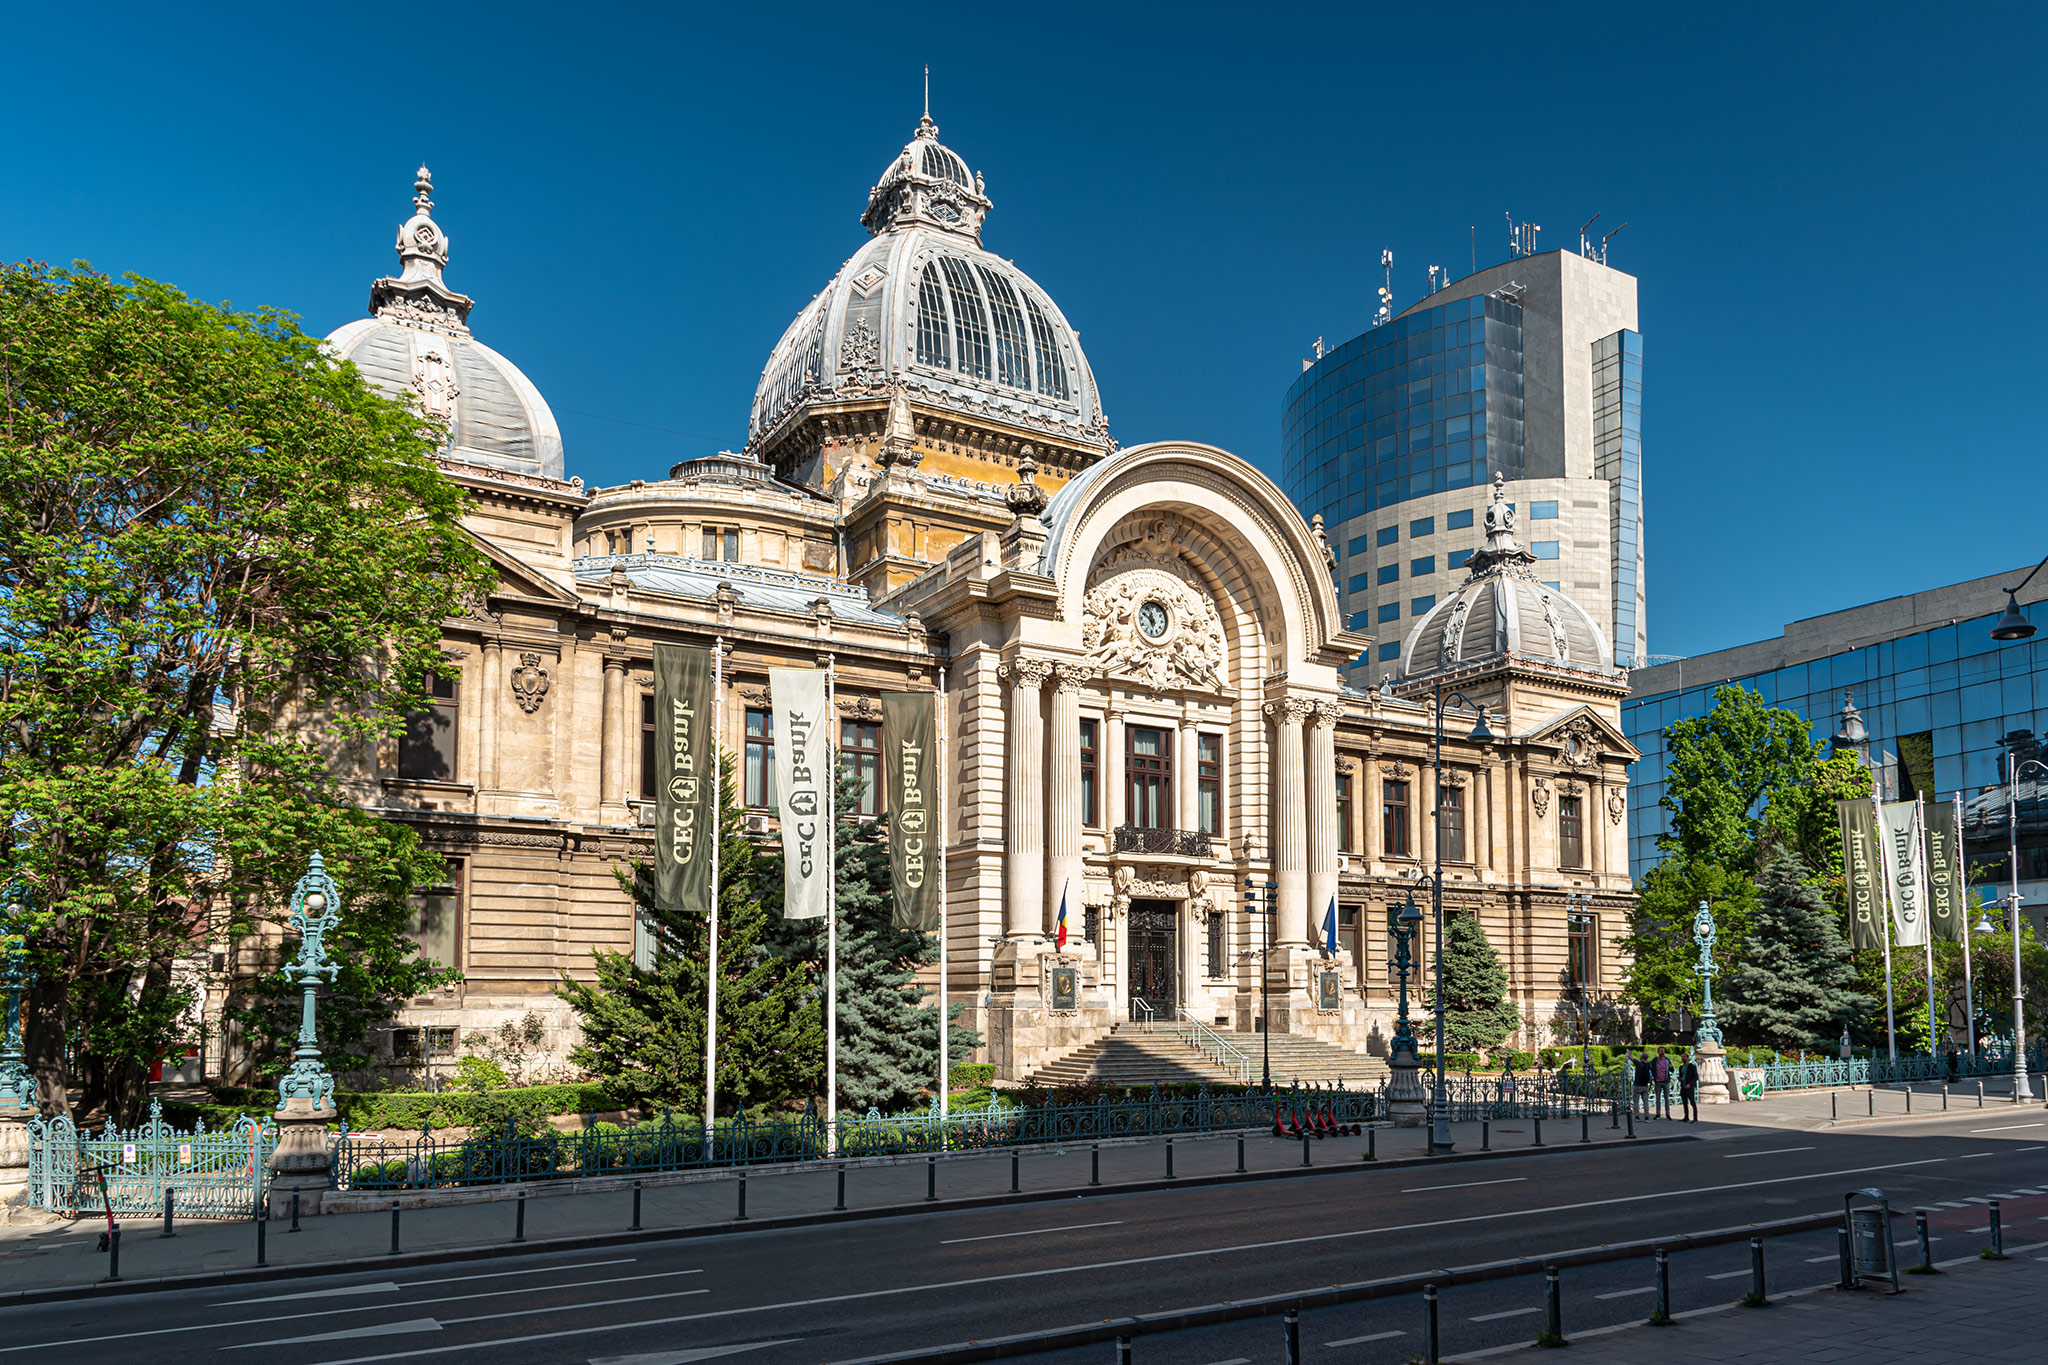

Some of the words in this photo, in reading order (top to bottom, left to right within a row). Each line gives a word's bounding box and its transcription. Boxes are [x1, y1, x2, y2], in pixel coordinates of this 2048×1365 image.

[673, 697, 695, 772] Bank
[790, 710, 812, 784] Bank
[901, 739, 923, 804] Bank
[673, 809, 694, 865] CEC
[797, 822, 816, 879] CEC
[1851, 828, 1867, 870] Bank
[1894, 827, 1911, 869] Bank
[1931, 830, 1947, 869] Bank
[905, 838, 925, 888] CEC
[1856, 890, 1871, 923] CEC
[1902, 889, 1916, 924] CEC
[1935, 887, 1950, 919] CEC
